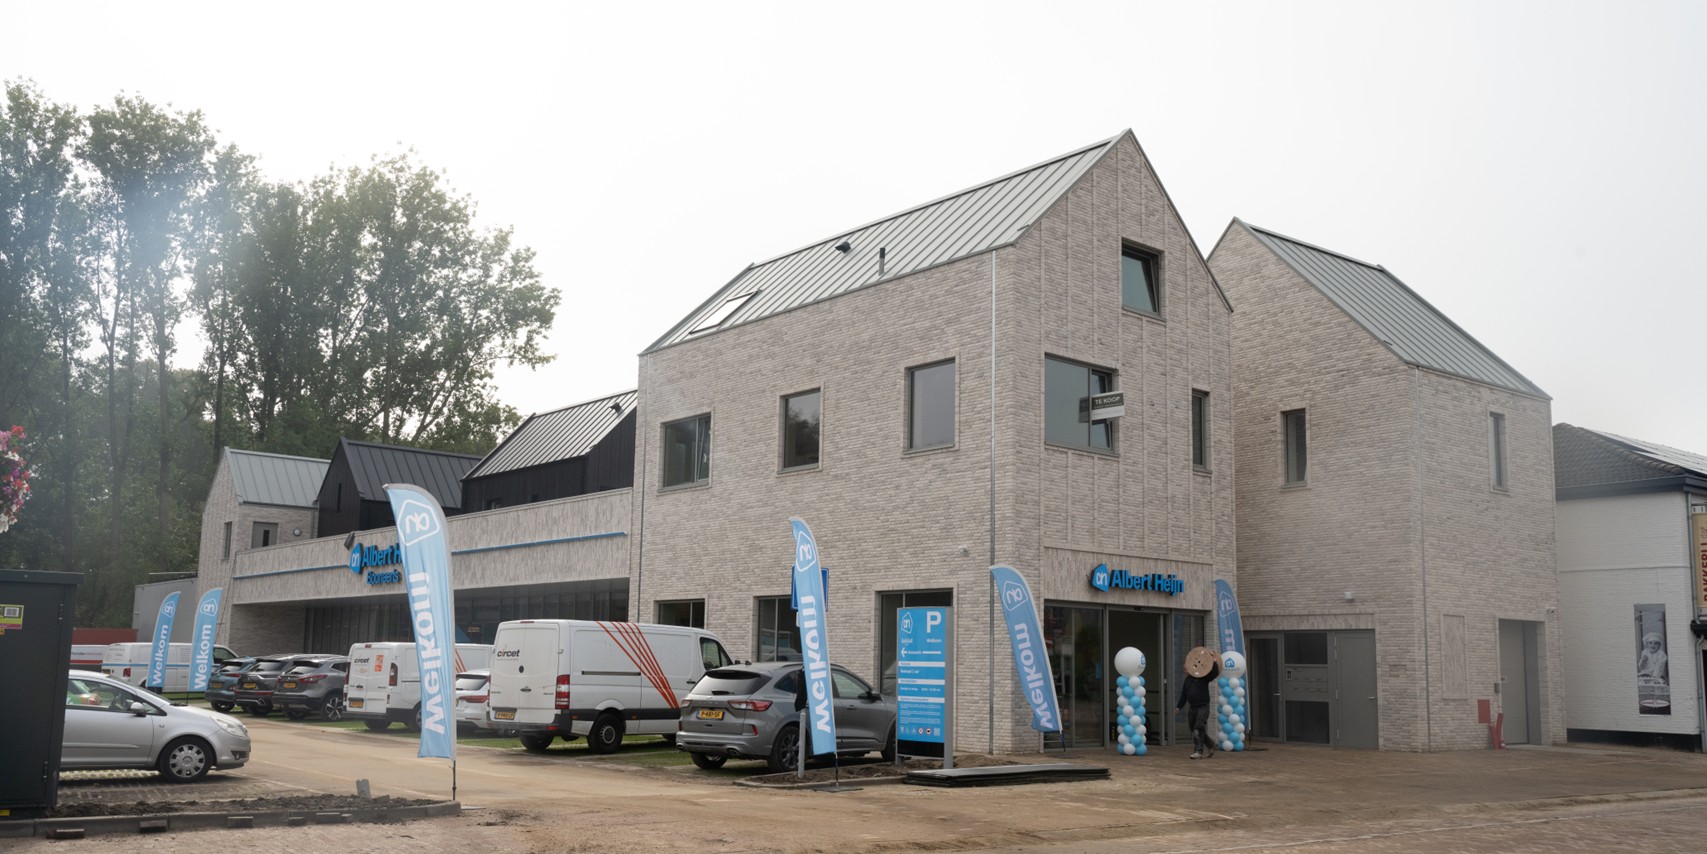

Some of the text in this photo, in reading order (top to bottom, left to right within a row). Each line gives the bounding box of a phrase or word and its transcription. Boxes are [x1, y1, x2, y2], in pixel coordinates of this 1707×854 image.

[1103, 396, 1121, 404] KOOP
[362, 545, 393, 567] Albert
[1111, 569, 1152, 591] Albert
[1154, 573, 1185, 597] Heijn
[926, 611, 942, 633] P
[152, 624, 168, 685] Welkom
[194, 624, 212, 689] Welkom
[497, 649, 520, 657] circet
